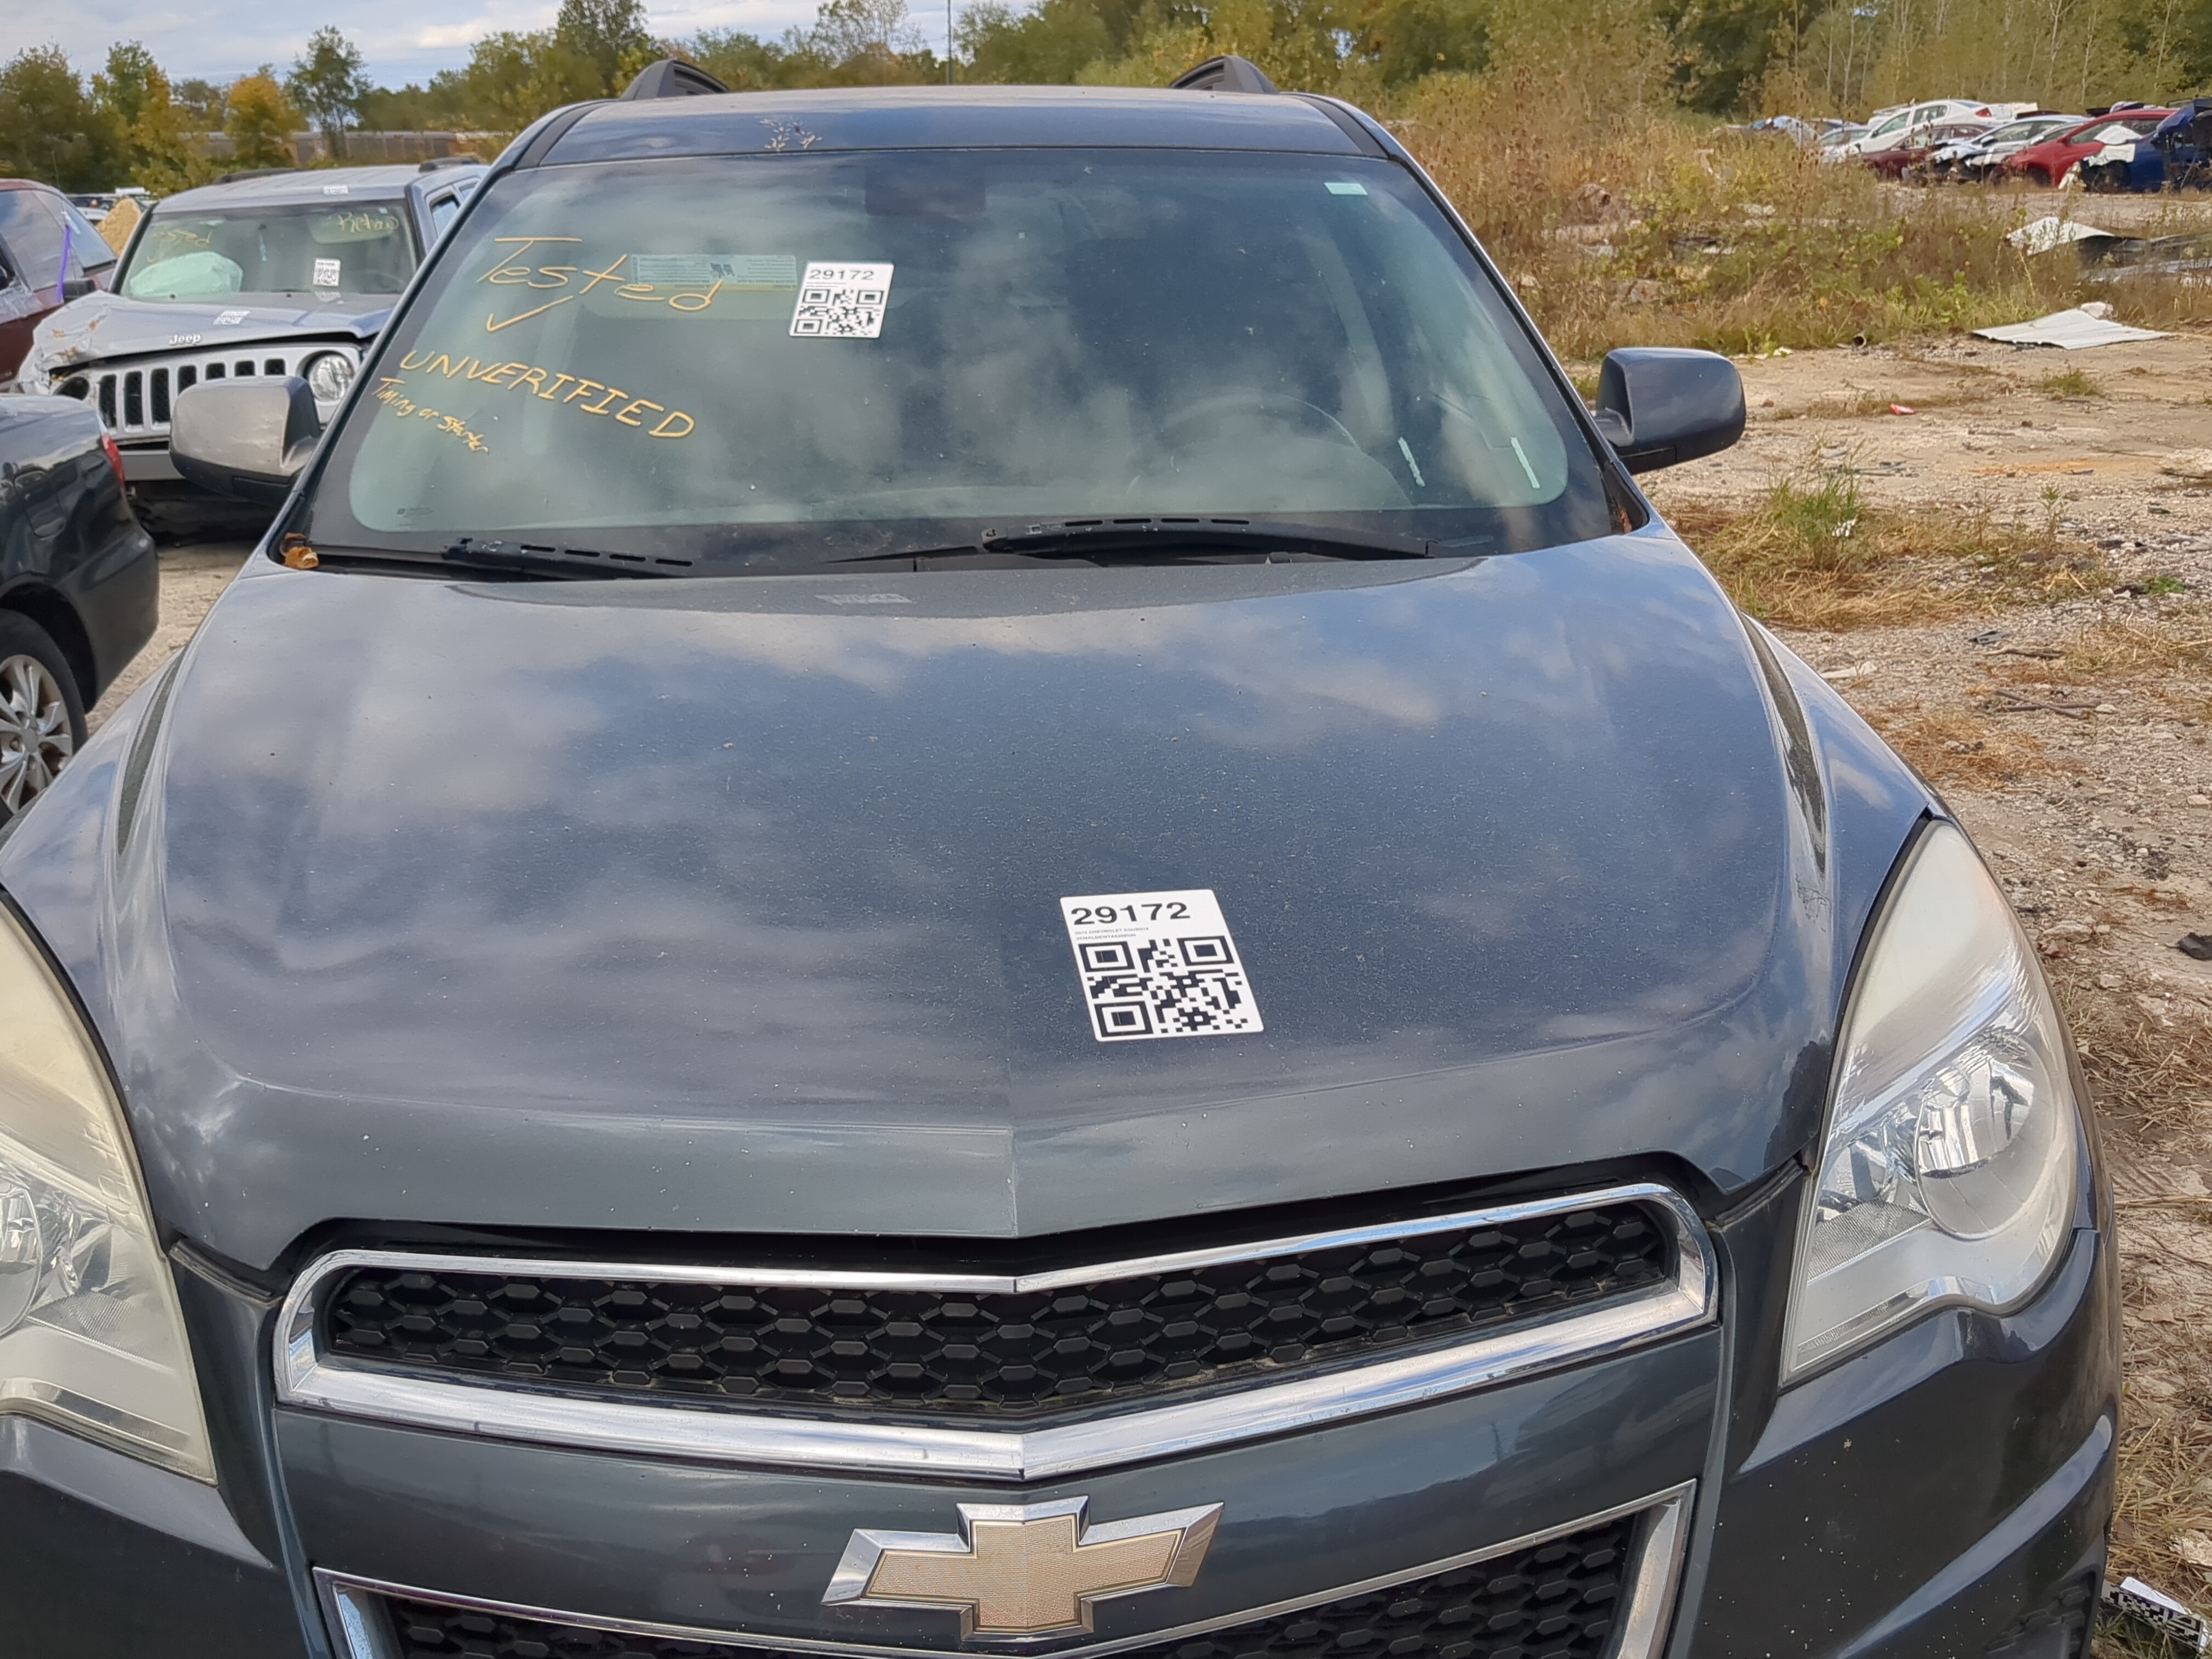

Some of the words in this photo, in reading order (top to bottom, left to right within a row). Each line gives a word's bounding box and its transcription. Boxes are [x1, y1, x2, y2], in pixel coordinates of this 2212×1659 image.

[477, 236, 724, 311] Tested
[808, 269, 874, 280] 29172
[168, 333, 201, 346] Jeep
[400, 349, 695, 438] UNVERIFIED
[418, 408, 439, 420] or
[1071, 902, 1190, 925] 29172
